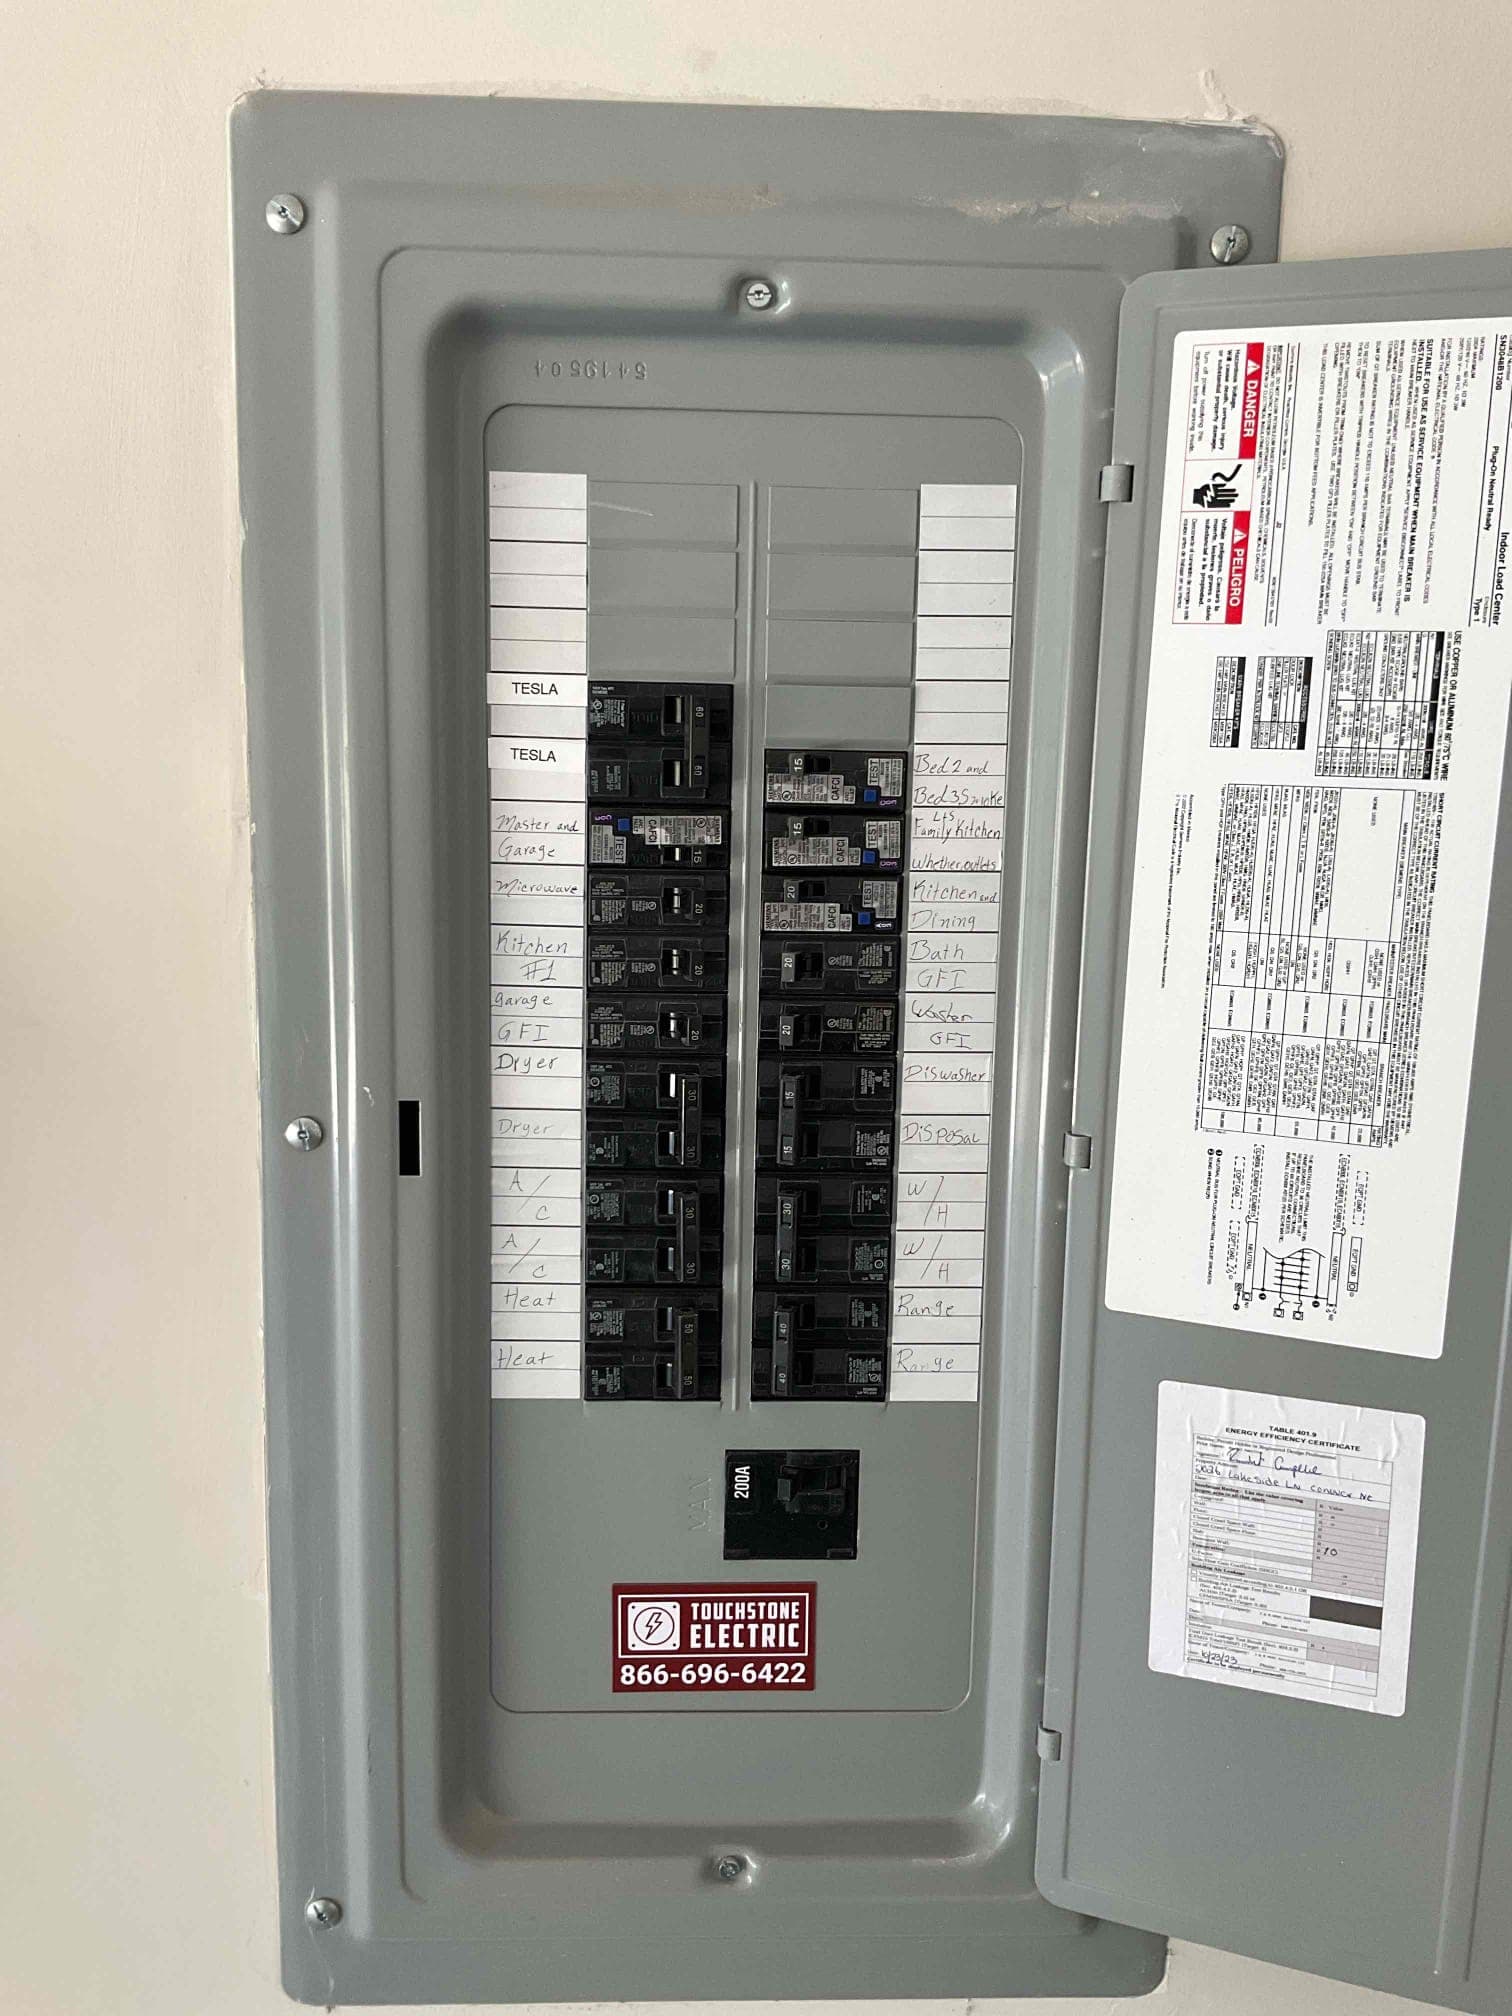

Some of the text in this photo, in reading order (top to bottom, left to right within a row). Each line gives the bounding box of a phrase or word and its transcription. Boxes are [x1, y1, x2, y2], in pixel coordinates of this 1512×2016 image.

[1414, 338, 1425, 383] INSTALLED.
[1423, 338, 1434, 376] SUITABLE
[1421, 378, 1430, 395] FOR
[1242, 379, 1258, 437] DANGER
[1419, 396, 1428, 414] USE
[1419, 413, 1427, 425] AS
[1415, 426, 1426, 460] SERVICE
[1411, 462, 1422, 507] EQUIPMENT
[1482, 445, 1499, 531] Plug-On Neutral Ready
[1409, 509, 1418, 533] WHEN
[1407, 534, 1416, 555] MAIN
[1228, 548, 1244, 606] PELIGRO
[1403, 556, 1414, 592] BREAKER
[1491, 531, 1510, 625] Indoor Load Center
[1472, 597, 1481, 615] Type
[1452, 630, 1462, 646] USE
[1449, 647, 1460, 677] COPPER
[511, 681, 559, 696] TESLA
[1448, 679, 1457, 690] OR
[695, 706, 704, 719] 60
[1444, 692, 1456, 730] ALUMINUM
[510, 748, 556, 763] TESLA
[794, 758, 803, 772] 15
[913, 753, 988, 775] Bed 2 and
[694, 764, 702, 777] 60
[869, 759, 879, 784] TEST
[1440, 762, 1449, 781] WIRE
[831, 777, 840, 801] CAFCI
[914, 784, 948, 805] Bed
[1436, 791, 1444, 813] SHORT
[496, 814, 579, 833] Master and
[648, 819, 657, 843] CAFCI
[793, 822, 802, 835] 15
[915, 817, 1001, 844] Family Kitchen
[867, 823, 877, 847] TEST
[498, 836, 555, 862] Garage
[615, 838, 625, 862] TEST
[693, 850, 702, 864] 15
[836, 839, 845, 863] CAFCI
[1431, 840, 1440, 869] CURRENT
[496, 878, 578, 897] Microwave
[787, 886, 796, 899] 20
[863, 882, 872, 906] TEST
[913, 879, 997, 902] Kitchen and
[695, 902, 703, 915] 20
[827, 905, 837, 928] CAFCI
[911, 909, 976, 932] Dining
[496, 930, 568, 956] Kitchen
[910, 939, 964, 960] Bath
[694, 963, 703, 976] 20
[784, 956, 793, 969] 20
[918, 967, 967, 992] GFI
[498, 1021, 550, 1042] GFI
[691, 1029, 699, 1042] 20
[782, 1024, 791, 1036] 20
[930, 1031, 972, 1050] GFI
[494, 1053, 559, 1074] Dryer
[688, 1088, 697, 1102] 30
[786, 1090, 794, 1101] 15
[498, 1118, 553, 1137] Dryer
[687, 1145, 696, 1158] 30
[784, 1144, 792, 1155] 15
[686, 1206, 695, 1220] 30
[783, 1203, 792, 1216] 30
[781, 1258, 791, 1271] 30
[1245, 1243, 1254, 1270] NEUTRAL
[687, 1262, 696, 1276] 30
[1330, 1255, 1338, 1281] NEUTRAL
[504, 1287, 556, 1310] Heat
[897, 1293, 954, 1317] Range
[684, 1323, 694, 1335] 50
[780, 1323, 787, 1334] 40
[497, 1345, 554, 1369] Heat
[897, 1348, 954, 1373] Range
[683, 1375, 693, 1387] 50
[779, 1372, 787, 1385] 40
[1225, 1426, 1258, 1437] ENERGY
[1259, 1431, 1306, 1445] EFFICIENCY
[1307, 1438, 1361, 1452] CERTIFICATE
[1269, 1425, 1295, 1435] TABLE
[734, 1465, 751, 1499] 200A
[690, 1601, 800, 1621] TOUCHSTONE
[690, 1623, 800, 1649] ELECTRIC
[620, 1662, 806, 1685] 866-696-6422
